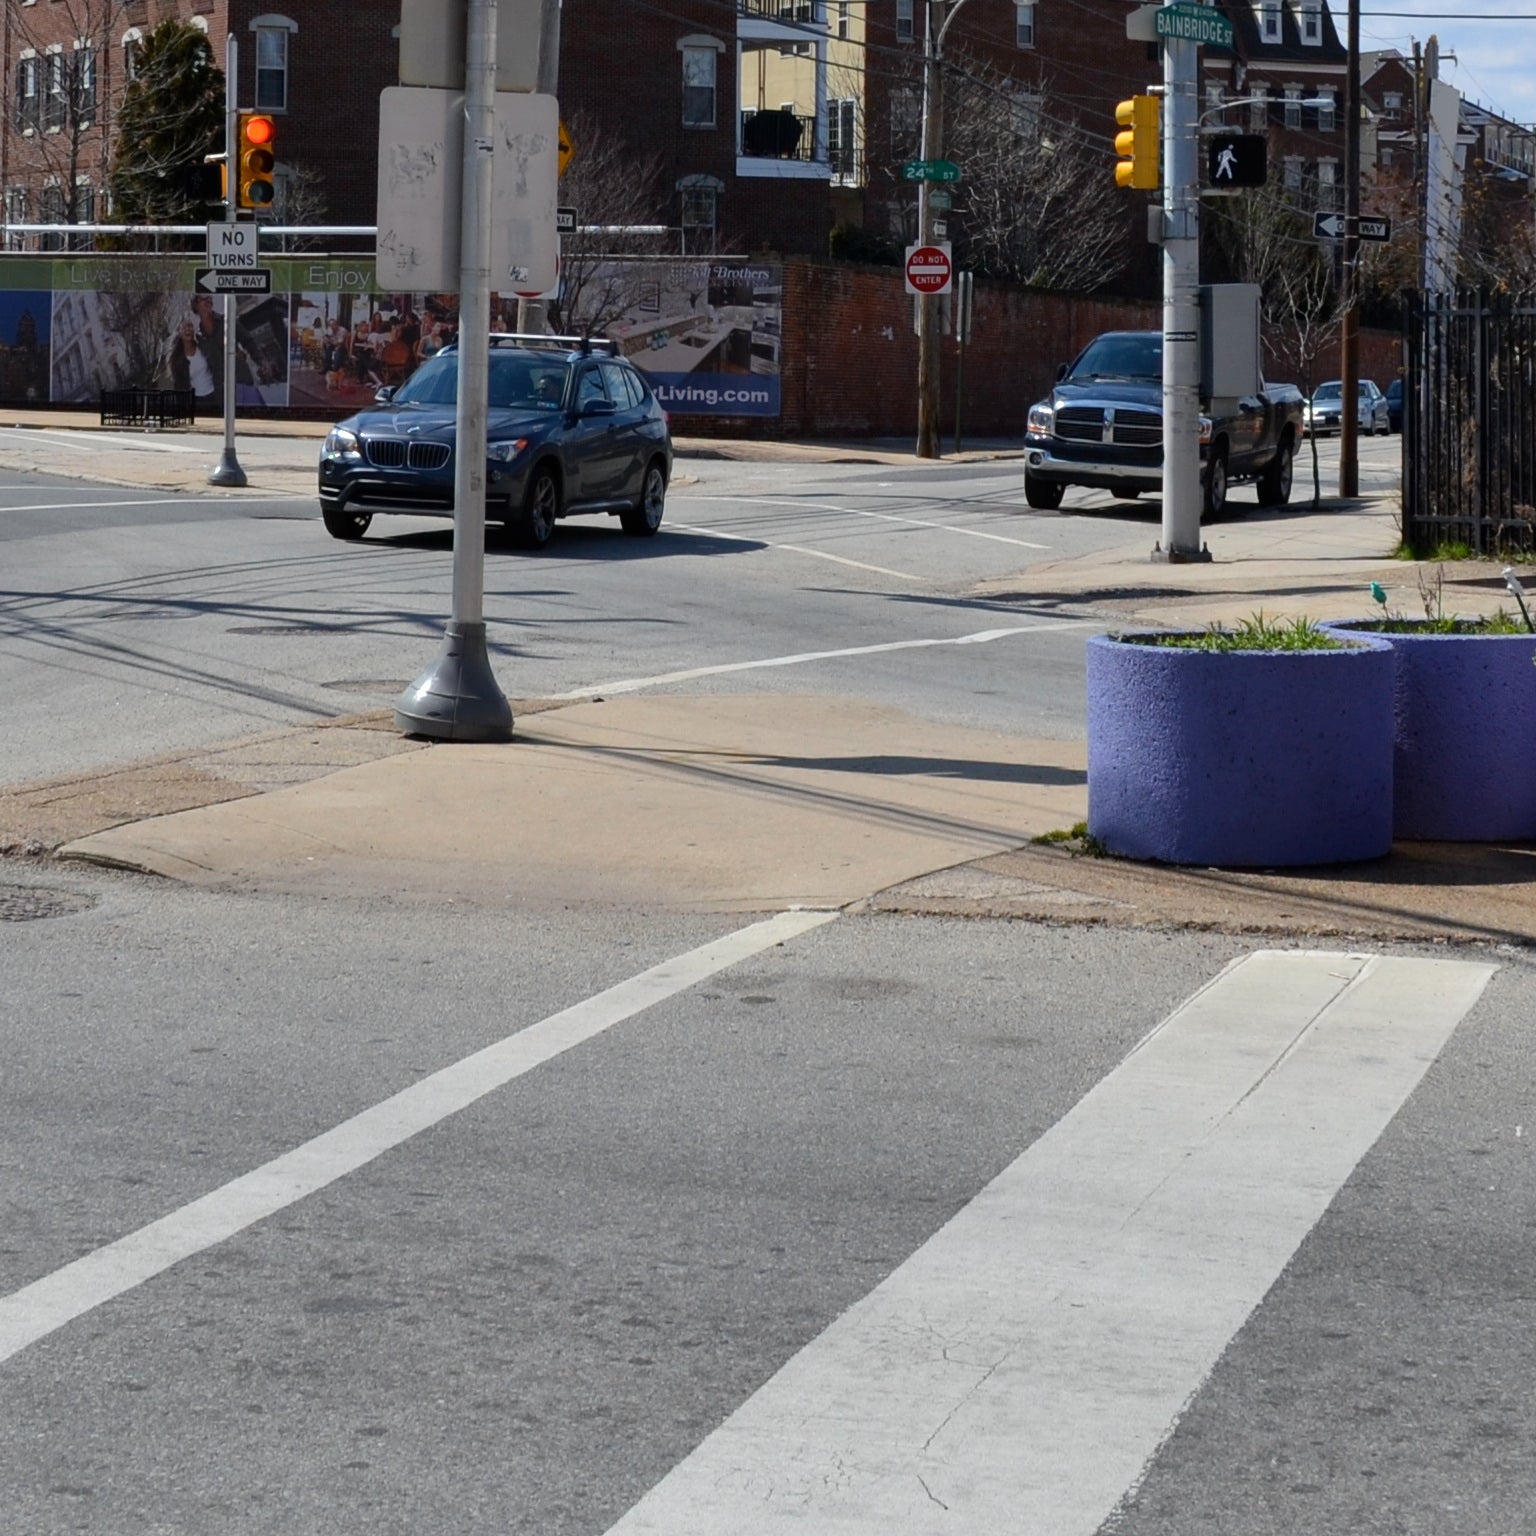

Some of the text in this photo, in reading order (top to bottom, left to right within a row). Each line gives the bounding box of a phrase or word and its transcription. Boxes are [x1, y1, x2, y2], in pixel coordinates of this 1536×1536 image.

[1157, 13, 1233, 44] BAINBRIDGE ST
[906, 167, 954, 180] 24TH ST
[1361, 223, 1382, 234] WAY
[222, 231, 244, 246] NO
[212, 254, 254, 266] TURNS
[912, 255, 944, 264] DO NOT
[71, 265, 112, 283] Live
[308, 266, 371, 289] Enjoy
[713, 266, 770, 280] Brothers
[217, 276, 264, 287] ONE WAY
[916, 276, 942, 284] ENTER
